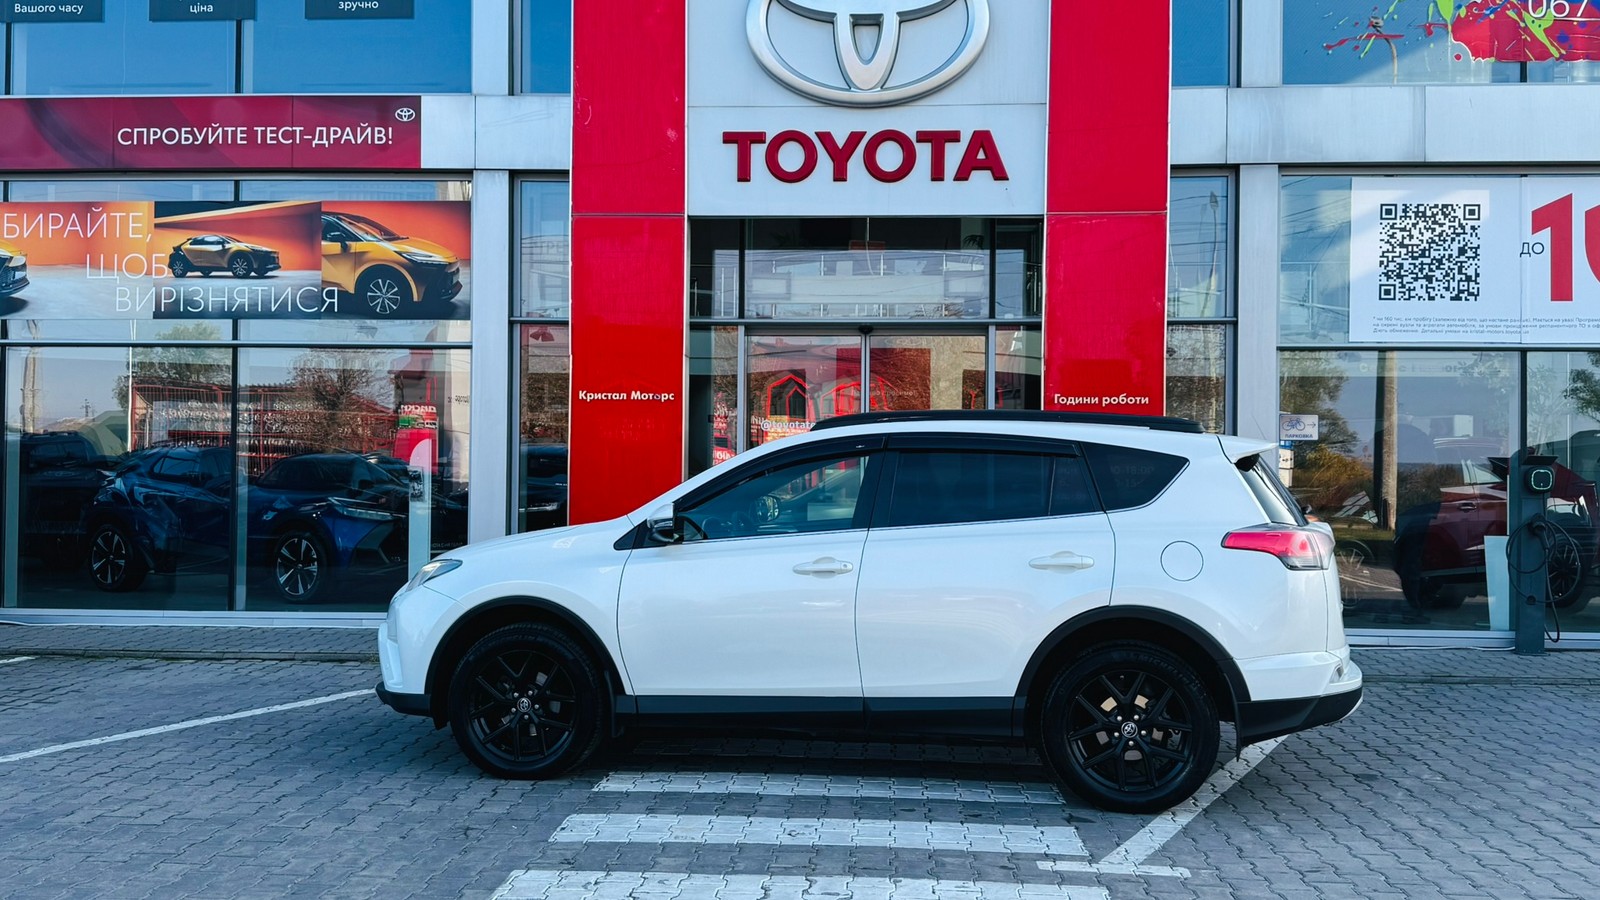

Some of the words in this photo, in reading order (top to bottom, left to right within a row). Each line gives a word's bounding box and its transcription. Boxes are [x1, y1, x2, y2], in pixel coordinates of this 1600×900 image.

[14, 3, 56, 13] Вашого
[58, 4, 84, 14] часу
[189, 3, 214, 14] ціна
[338, 1, 379, 12] зручно
[117, 123, 248, 145] СПРОБУЙТЕ
[253, 123, 394, 148] ТЕСТ-ДРАЙВ!
[722, 129, 1009, 183] TOYOTA
[3, 207, 152, 243] БИРАЙТЕ,
[1530, 192, 1600, 302] 1
[85, 251, 168, 284] ЩОБ
[115, 286, 339, 313] ВИРІЗНЯТИСЯ
[578, 390, 627, 402] Кристал
[630, 390, 675, 402] Моторс
[1054, 393, 1099, 405] Години
[1101, 393, 1150, 407] роботи
